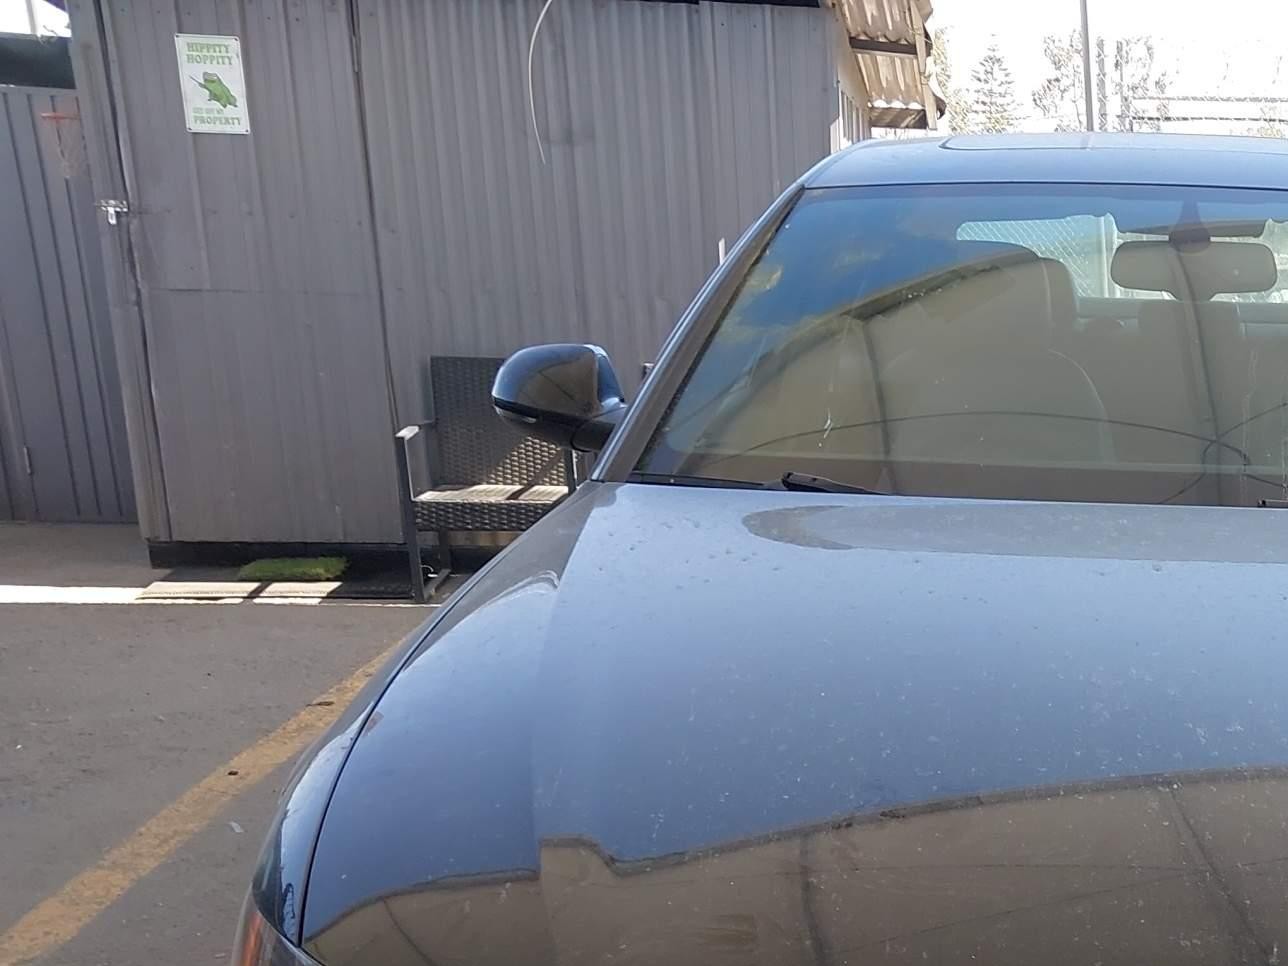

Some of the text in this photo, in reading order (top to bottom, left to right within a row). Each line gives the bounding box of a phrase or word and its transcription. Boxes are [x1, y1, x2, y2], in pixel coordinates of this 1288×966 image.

[186, 43, 230, 53] HIPPITY
[186, 54, 232, 65] HOPPITY
[193, 116, 241, 125] PROPERTY
